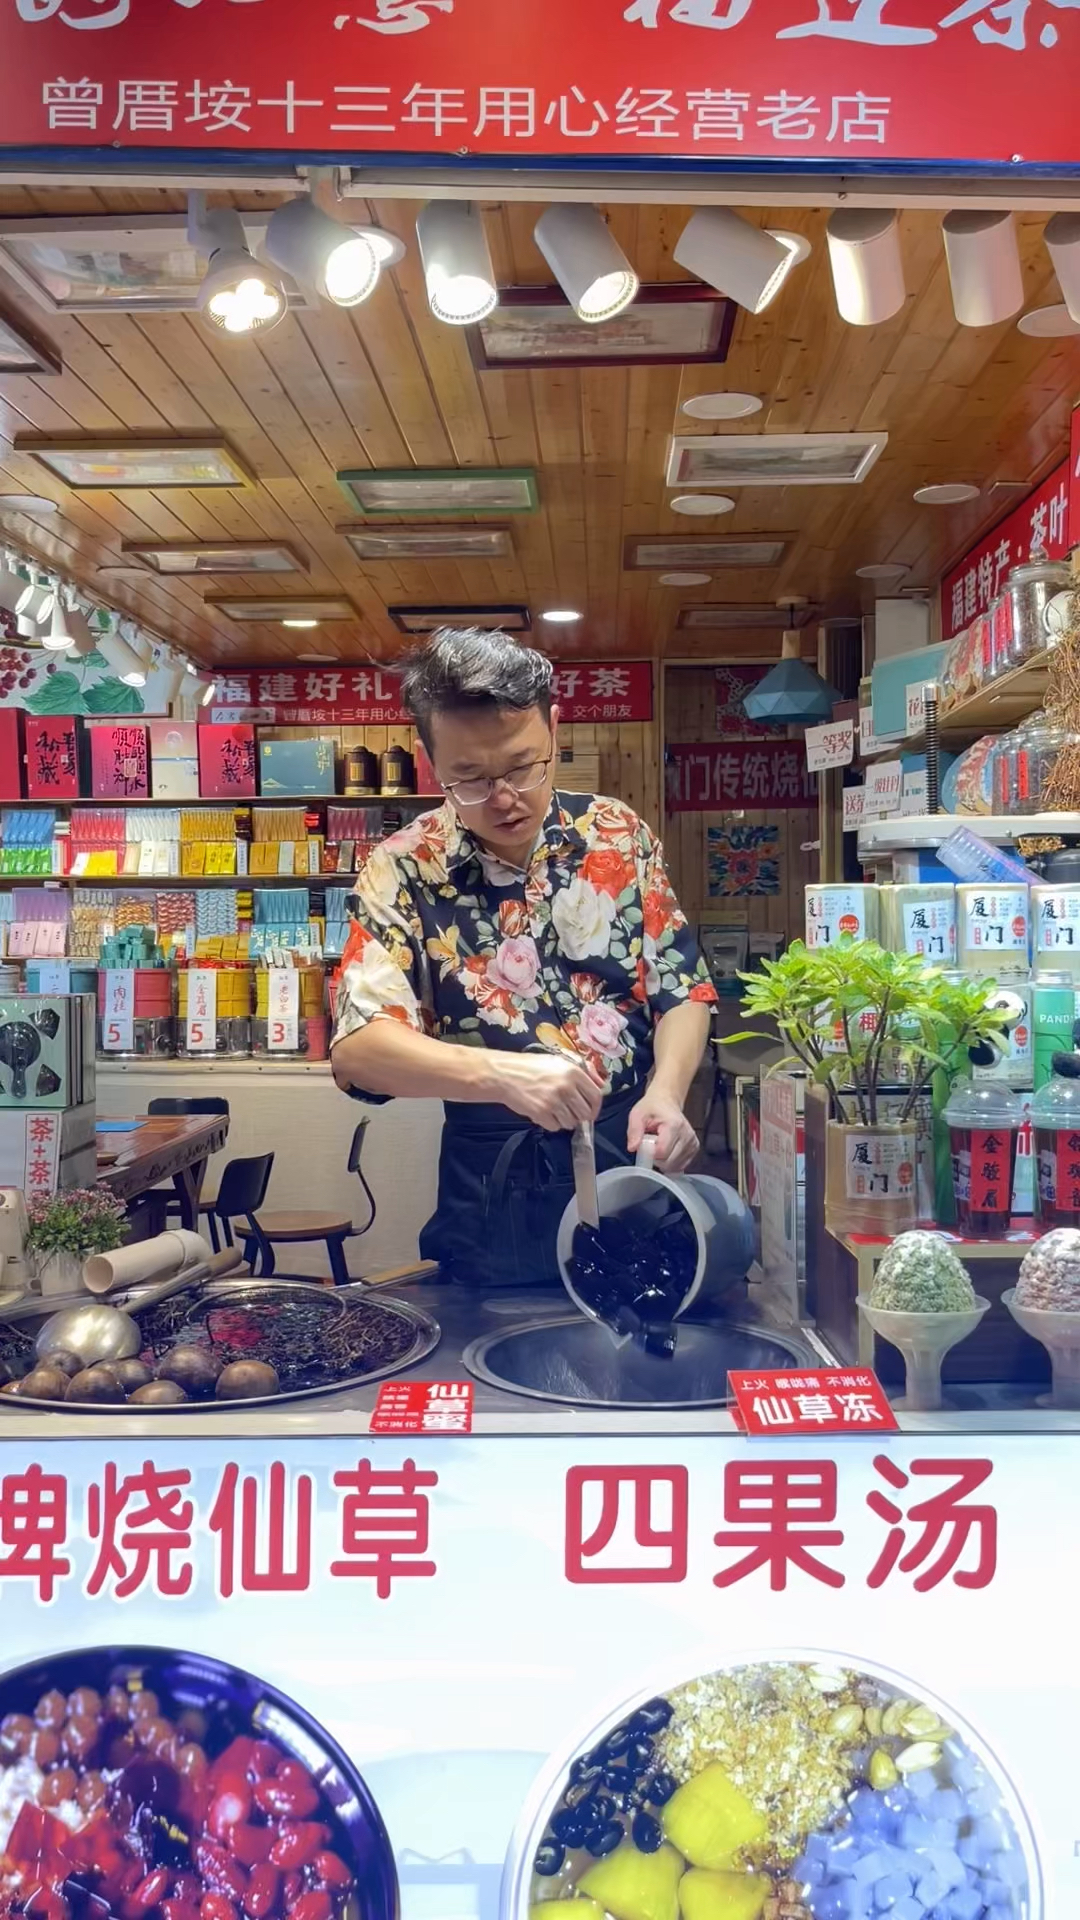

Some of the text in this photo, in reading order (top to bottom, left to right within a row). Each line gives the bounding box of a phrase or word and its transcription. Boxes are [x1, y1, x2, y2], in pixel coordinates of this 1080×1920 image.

[42, 76, 892, 143] 曾厝垵十三年用心经营老店
[212, 672, 393, 703] 福建好礼
[573, 704, 632, 719] 交个朋友
[911, 908, 944, 954] 厦门
[969, 897, 1004, 944] 厦门
[1041, 898, 1074, 945] 厦门
[107, 1023, 121, 1043] 5
[191, 1023, 204, 1043] 5
[272, 1023, 286, 1043] 3
[851, 1142, 890, 1193] 厦门
[740, 1379, 770, 1391] 上火
[825, 1375, 872, 1388] 不消化
[752, 1392, 884, 1426] 仙草冻
[565, 1454, 998, 1593] 四果汤
